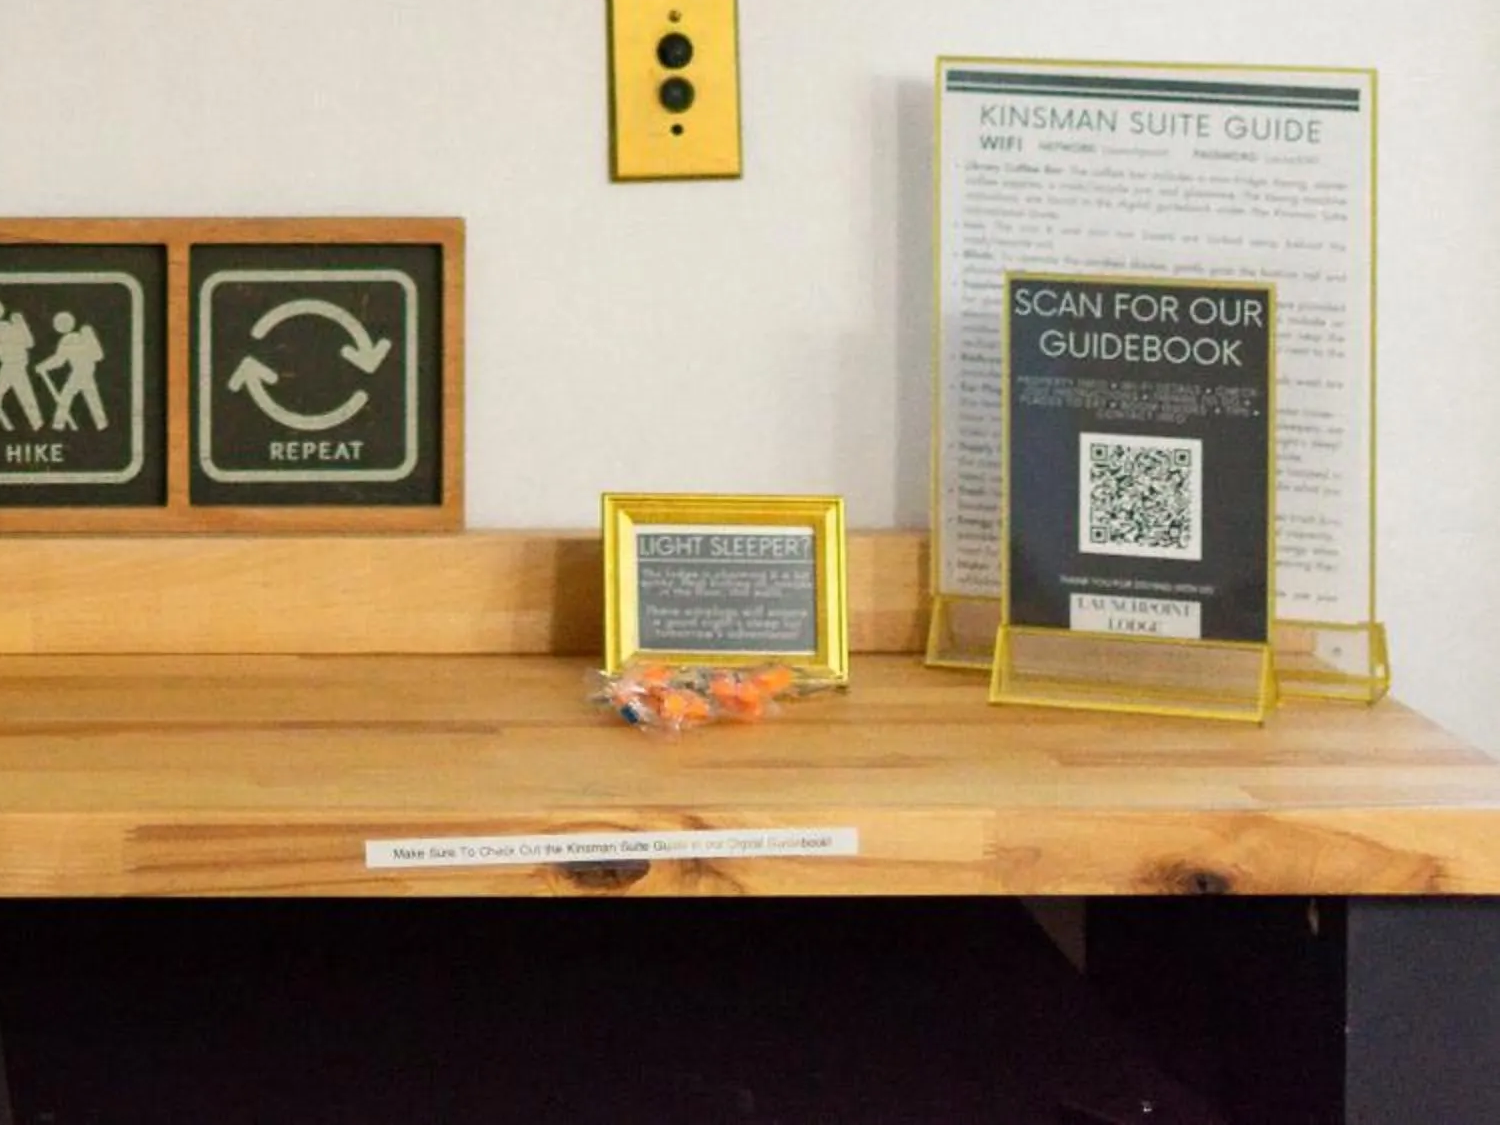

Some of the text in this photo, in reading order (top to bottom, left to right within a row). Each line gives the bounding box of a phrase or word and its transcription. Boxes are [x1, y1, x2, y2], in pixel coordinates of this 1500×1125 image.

[979, 104, 1323, 145] KINSMAN SUITE GUIDE
[979, 134, 1023, 153] WIFI
[1014, 288, 1264, 328] SCAN FOR OUR
[1038, 329, 1243, 366] GUIDEBOOK
[6, 444, 64, 464] HIKE
[269, 441, 365, 461] REPEAT
[639, 536, 812, 558] LIGHT SLEEPER?
[393, 847, 425, 860] Make
[429, 847, 456, 858] Sure
[461, 846, 475, 858] To
[479, 845, 515, 857] Check
[519, 843, 541, 856] Out
[567, 840, 617, 854] Kinsman
[620, 840, 649, 853] Suite
